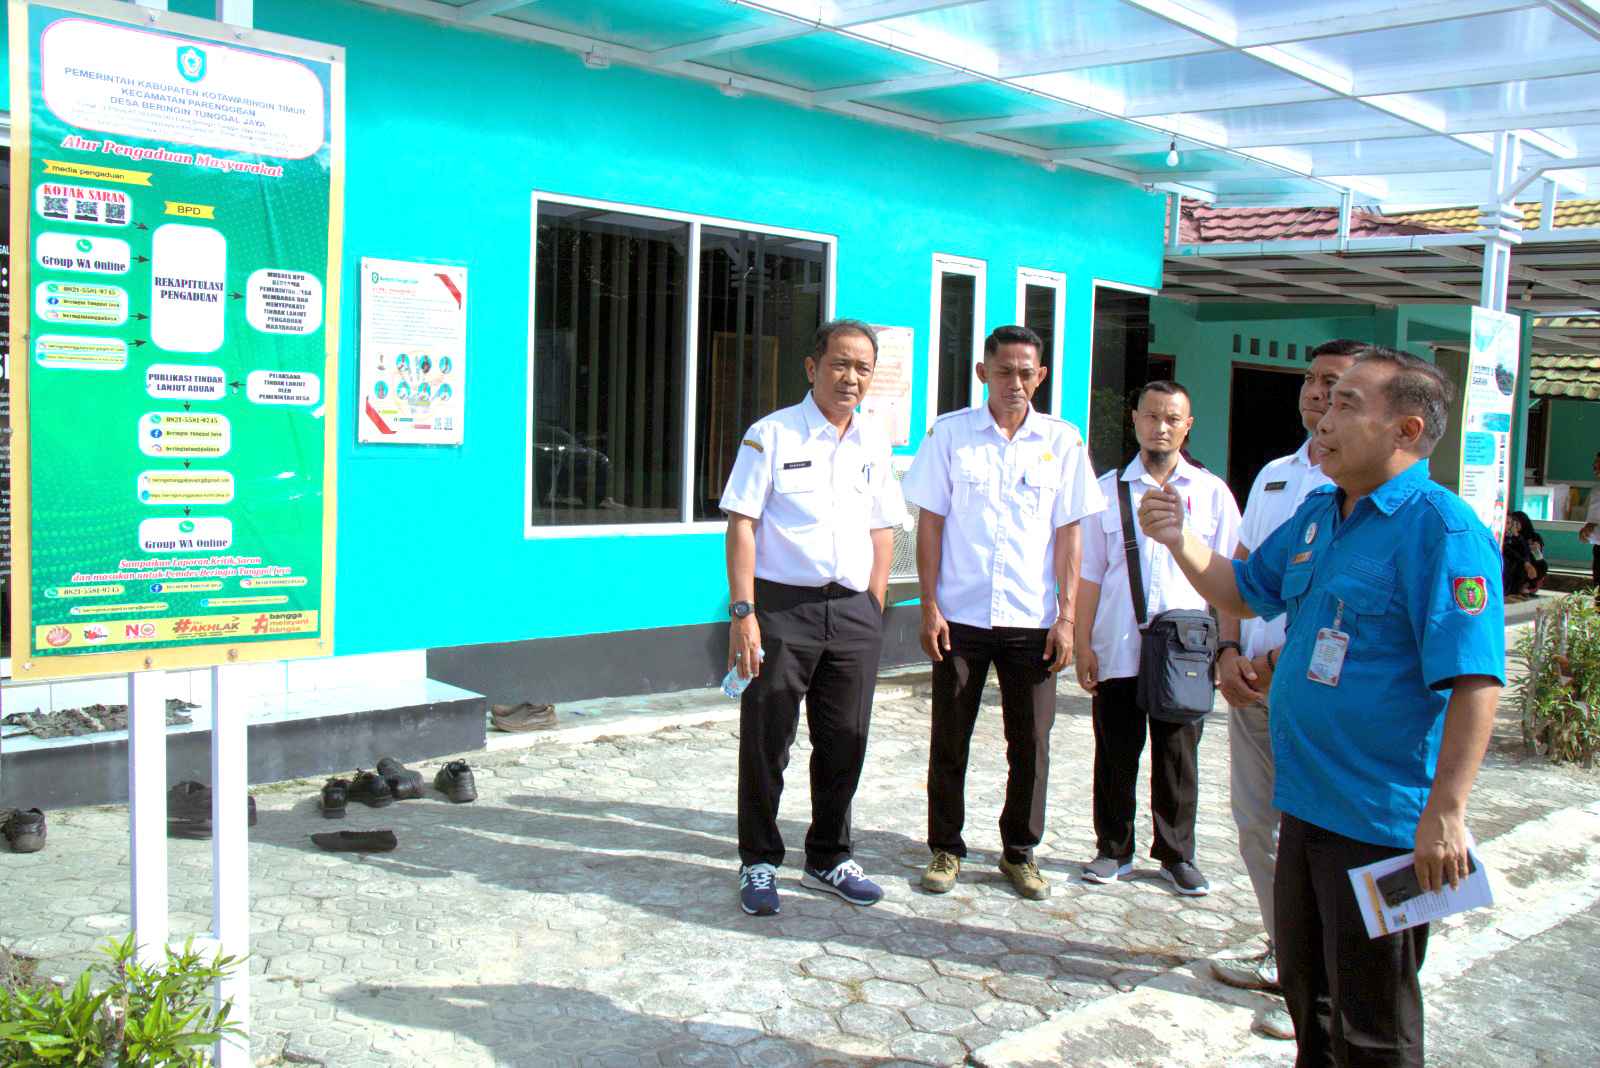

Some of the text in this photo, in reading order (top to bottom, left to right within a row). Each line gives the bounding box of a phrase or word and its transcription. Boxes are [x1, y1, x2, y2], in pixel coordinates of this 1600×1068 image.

[64, 66, 135, 86] PEMERINTAH
[137, 79, 199, 97] KABUPATEN
[277, 103, 306, 116] TIMUR
[121, 87, 187, 106] KECAMATAN
[110, 96, 139, 107] DESA
[141, 101, 192, 116] BERINGIN
[194, 109, 240, 124] TUNGGAL
[62, 135, 283, 177] Alur Pengaduan Masyarakat
[52, 165, 125, 181] media pengaduan
[43, 184, 125, 203] KOTAK SARAN
[177, 205, 201, 216] BPD
[42, 255, 126, 272] Group WA Online
[155, 276, 224, 291] REKAPITULASI
[160, 289, 218, 303] PENGADUAN
[148, 373, 224, 384] PUBLIKASI TINDAK
[156, 383, 215, 393] LANJUT ADUAN
[144, 538, 229, 550] Group WA Online
[119, 559, 171, 570] Sampaikan
[93, 571, 135, 581] masukan
[269, 612, 303, 620] bangga
